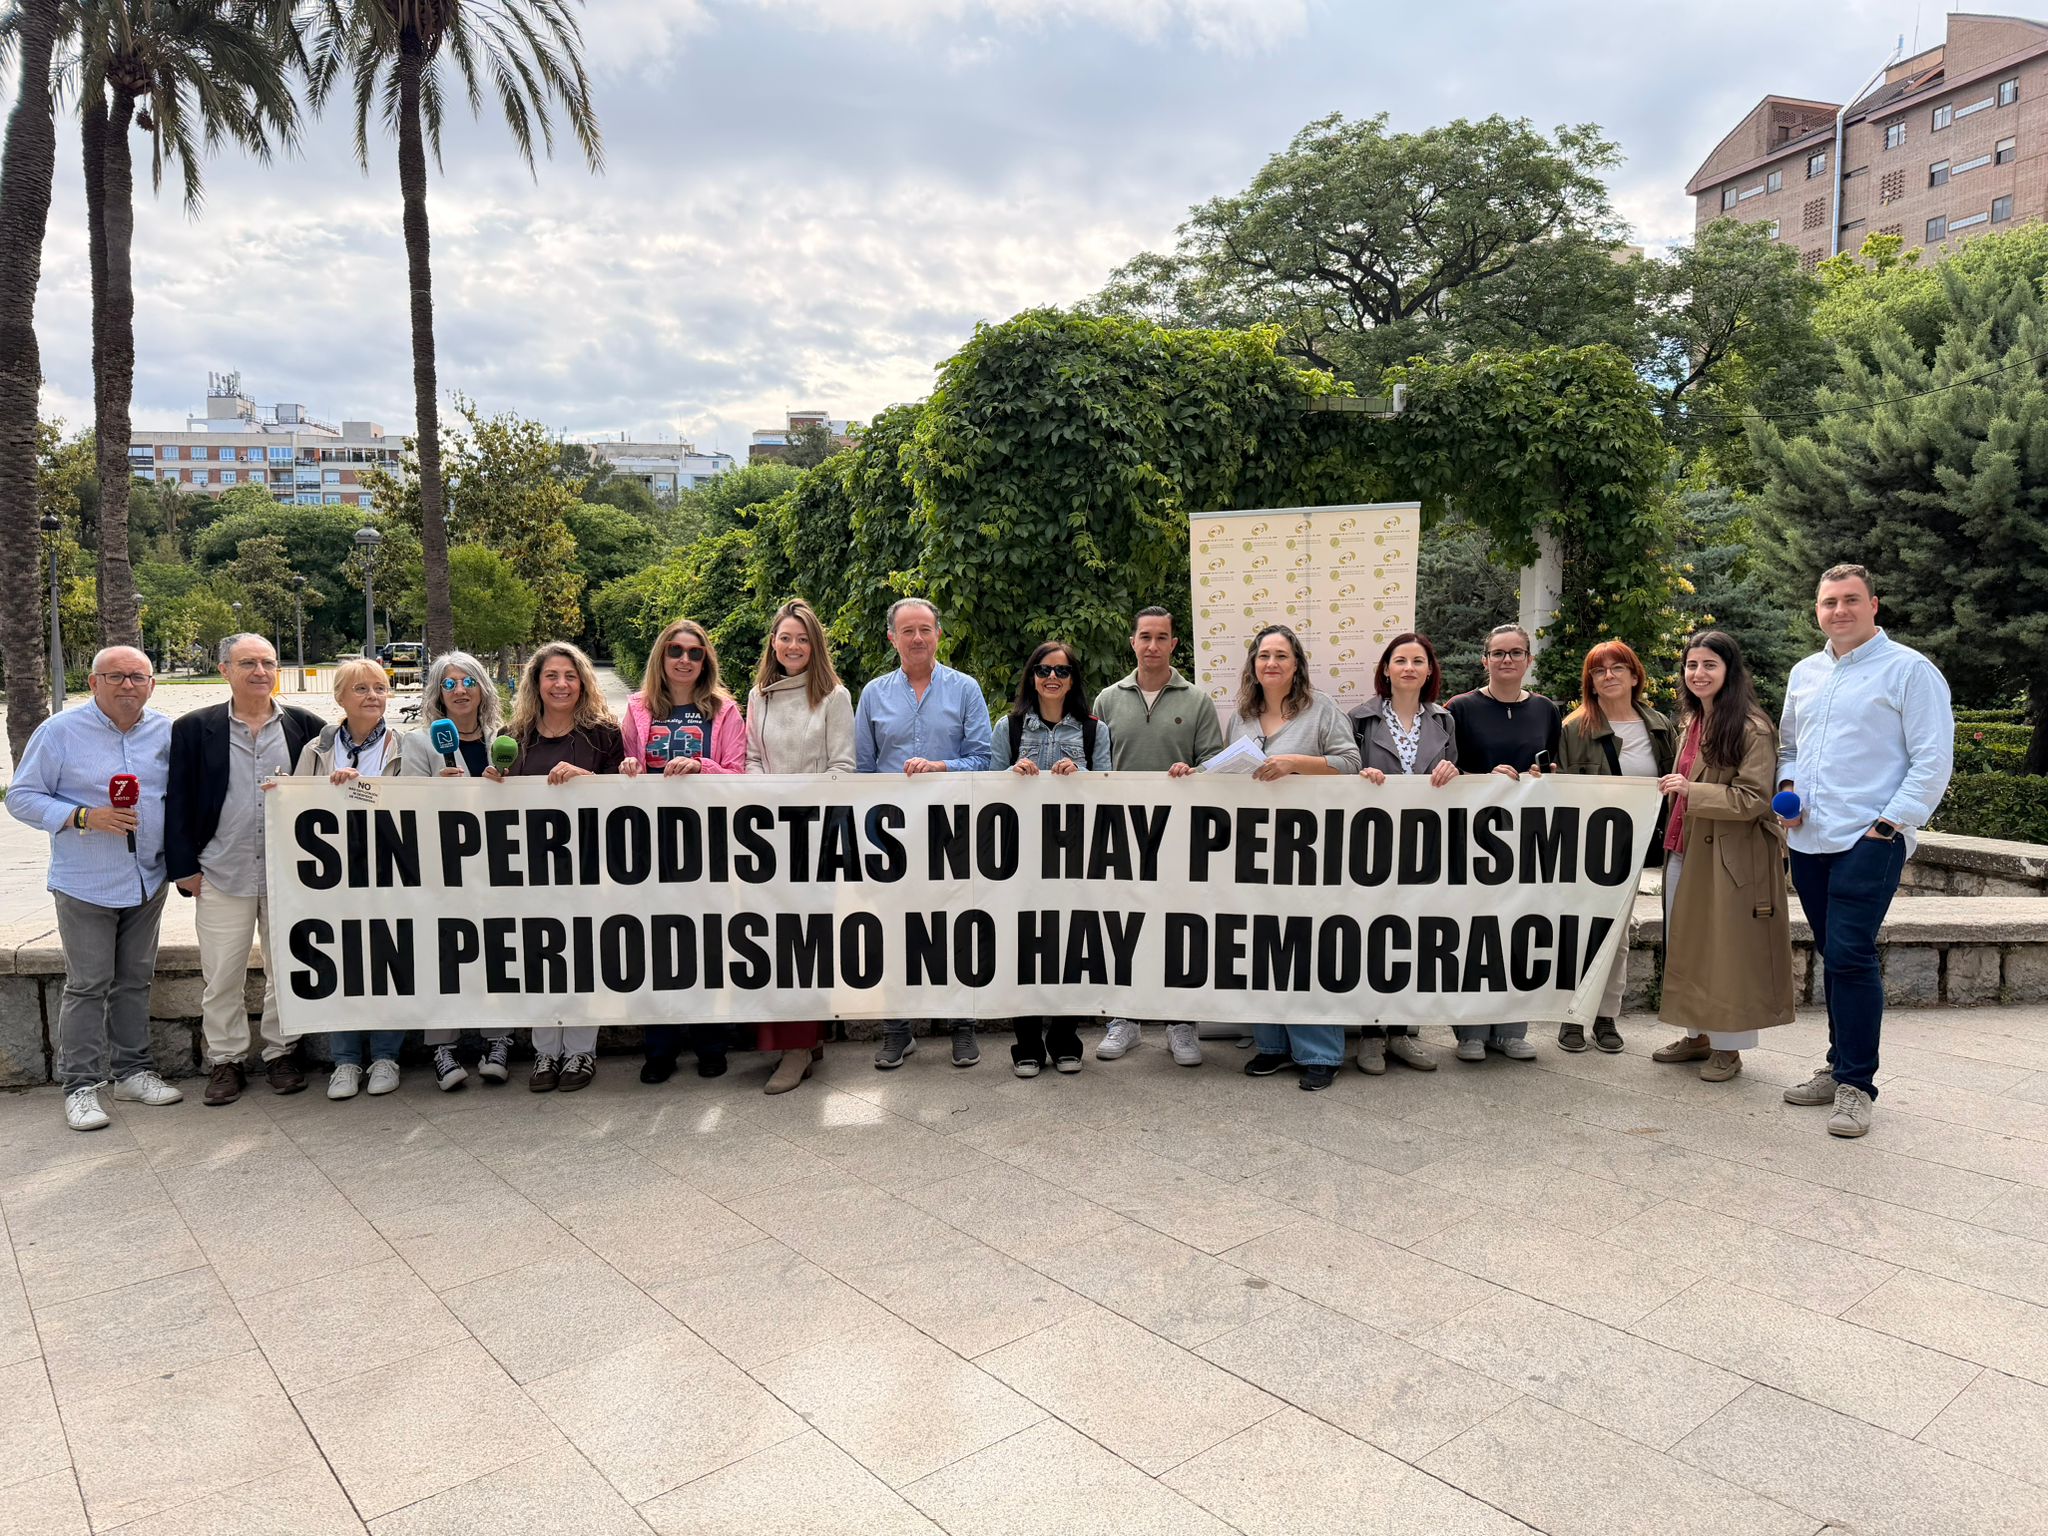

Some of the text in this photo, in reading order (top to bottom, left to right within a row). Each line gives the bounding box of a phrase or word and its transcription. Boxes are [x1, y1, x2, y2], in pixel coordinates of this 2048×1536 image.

[357, 781, 372, 791] NO
[294, 802, 1634, 891] SIN PERIODISTAS NO HAY PERIODISMO
[288, 918, 416, 1001] SIN
[437, 911, 884, 996] PERIODISMO
[905, 908, 996, 988] NO
[1017, 909, 1146, 987] HAY
